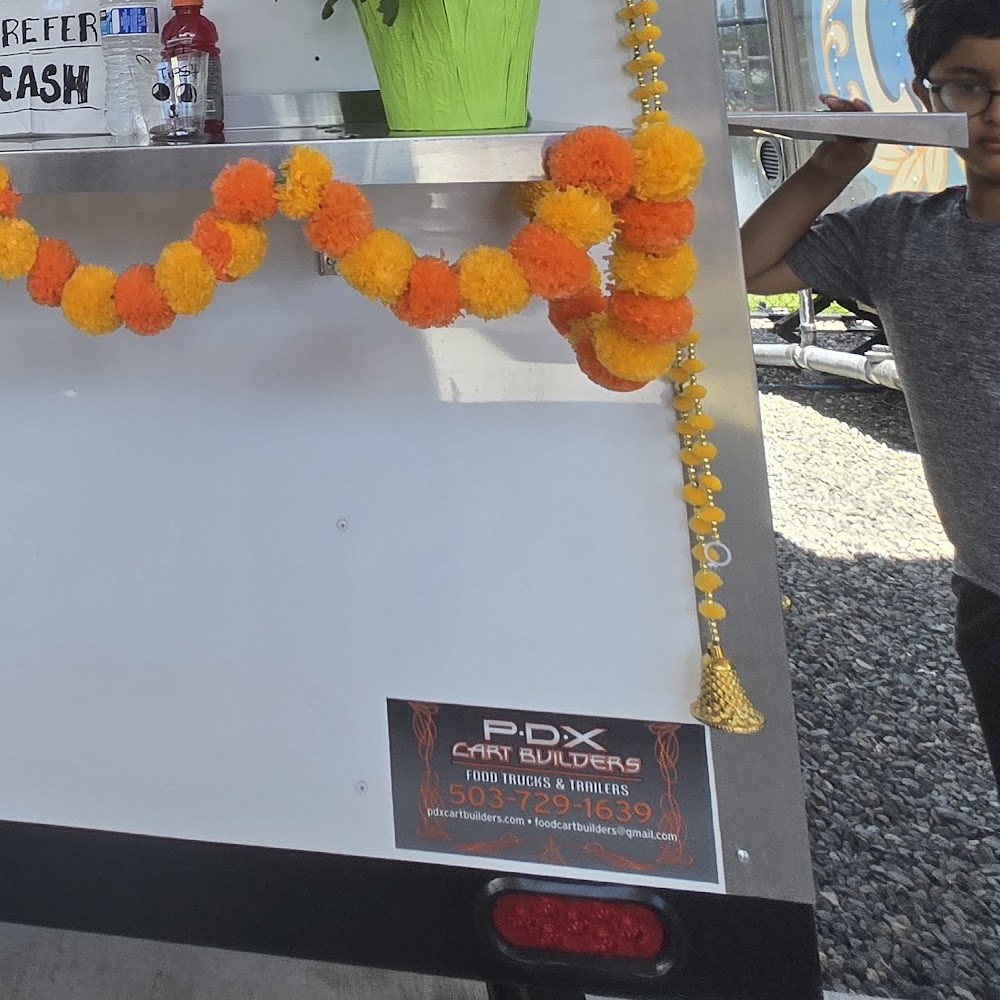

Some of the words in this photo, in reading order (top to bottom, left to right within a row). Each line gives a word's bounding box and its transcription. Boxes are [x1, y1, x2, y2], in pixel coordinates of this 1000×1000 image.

[452, 740, 515, 765] CART
[518, 746, 643, 776] BUILDERS
[466, 768, 498, 784] FOOD
[502, 773, 551, 790] TRUCKS
[556, 777, 566, 791] &
[569, 779, 629, 798] TRAILERS
[449, 784, 653, 825] 503-729-1639
[427, 807, 526, 827] pdxcartbuilders.com
[534, 817, 678, 843] foodcartbuilders@gmail.com
